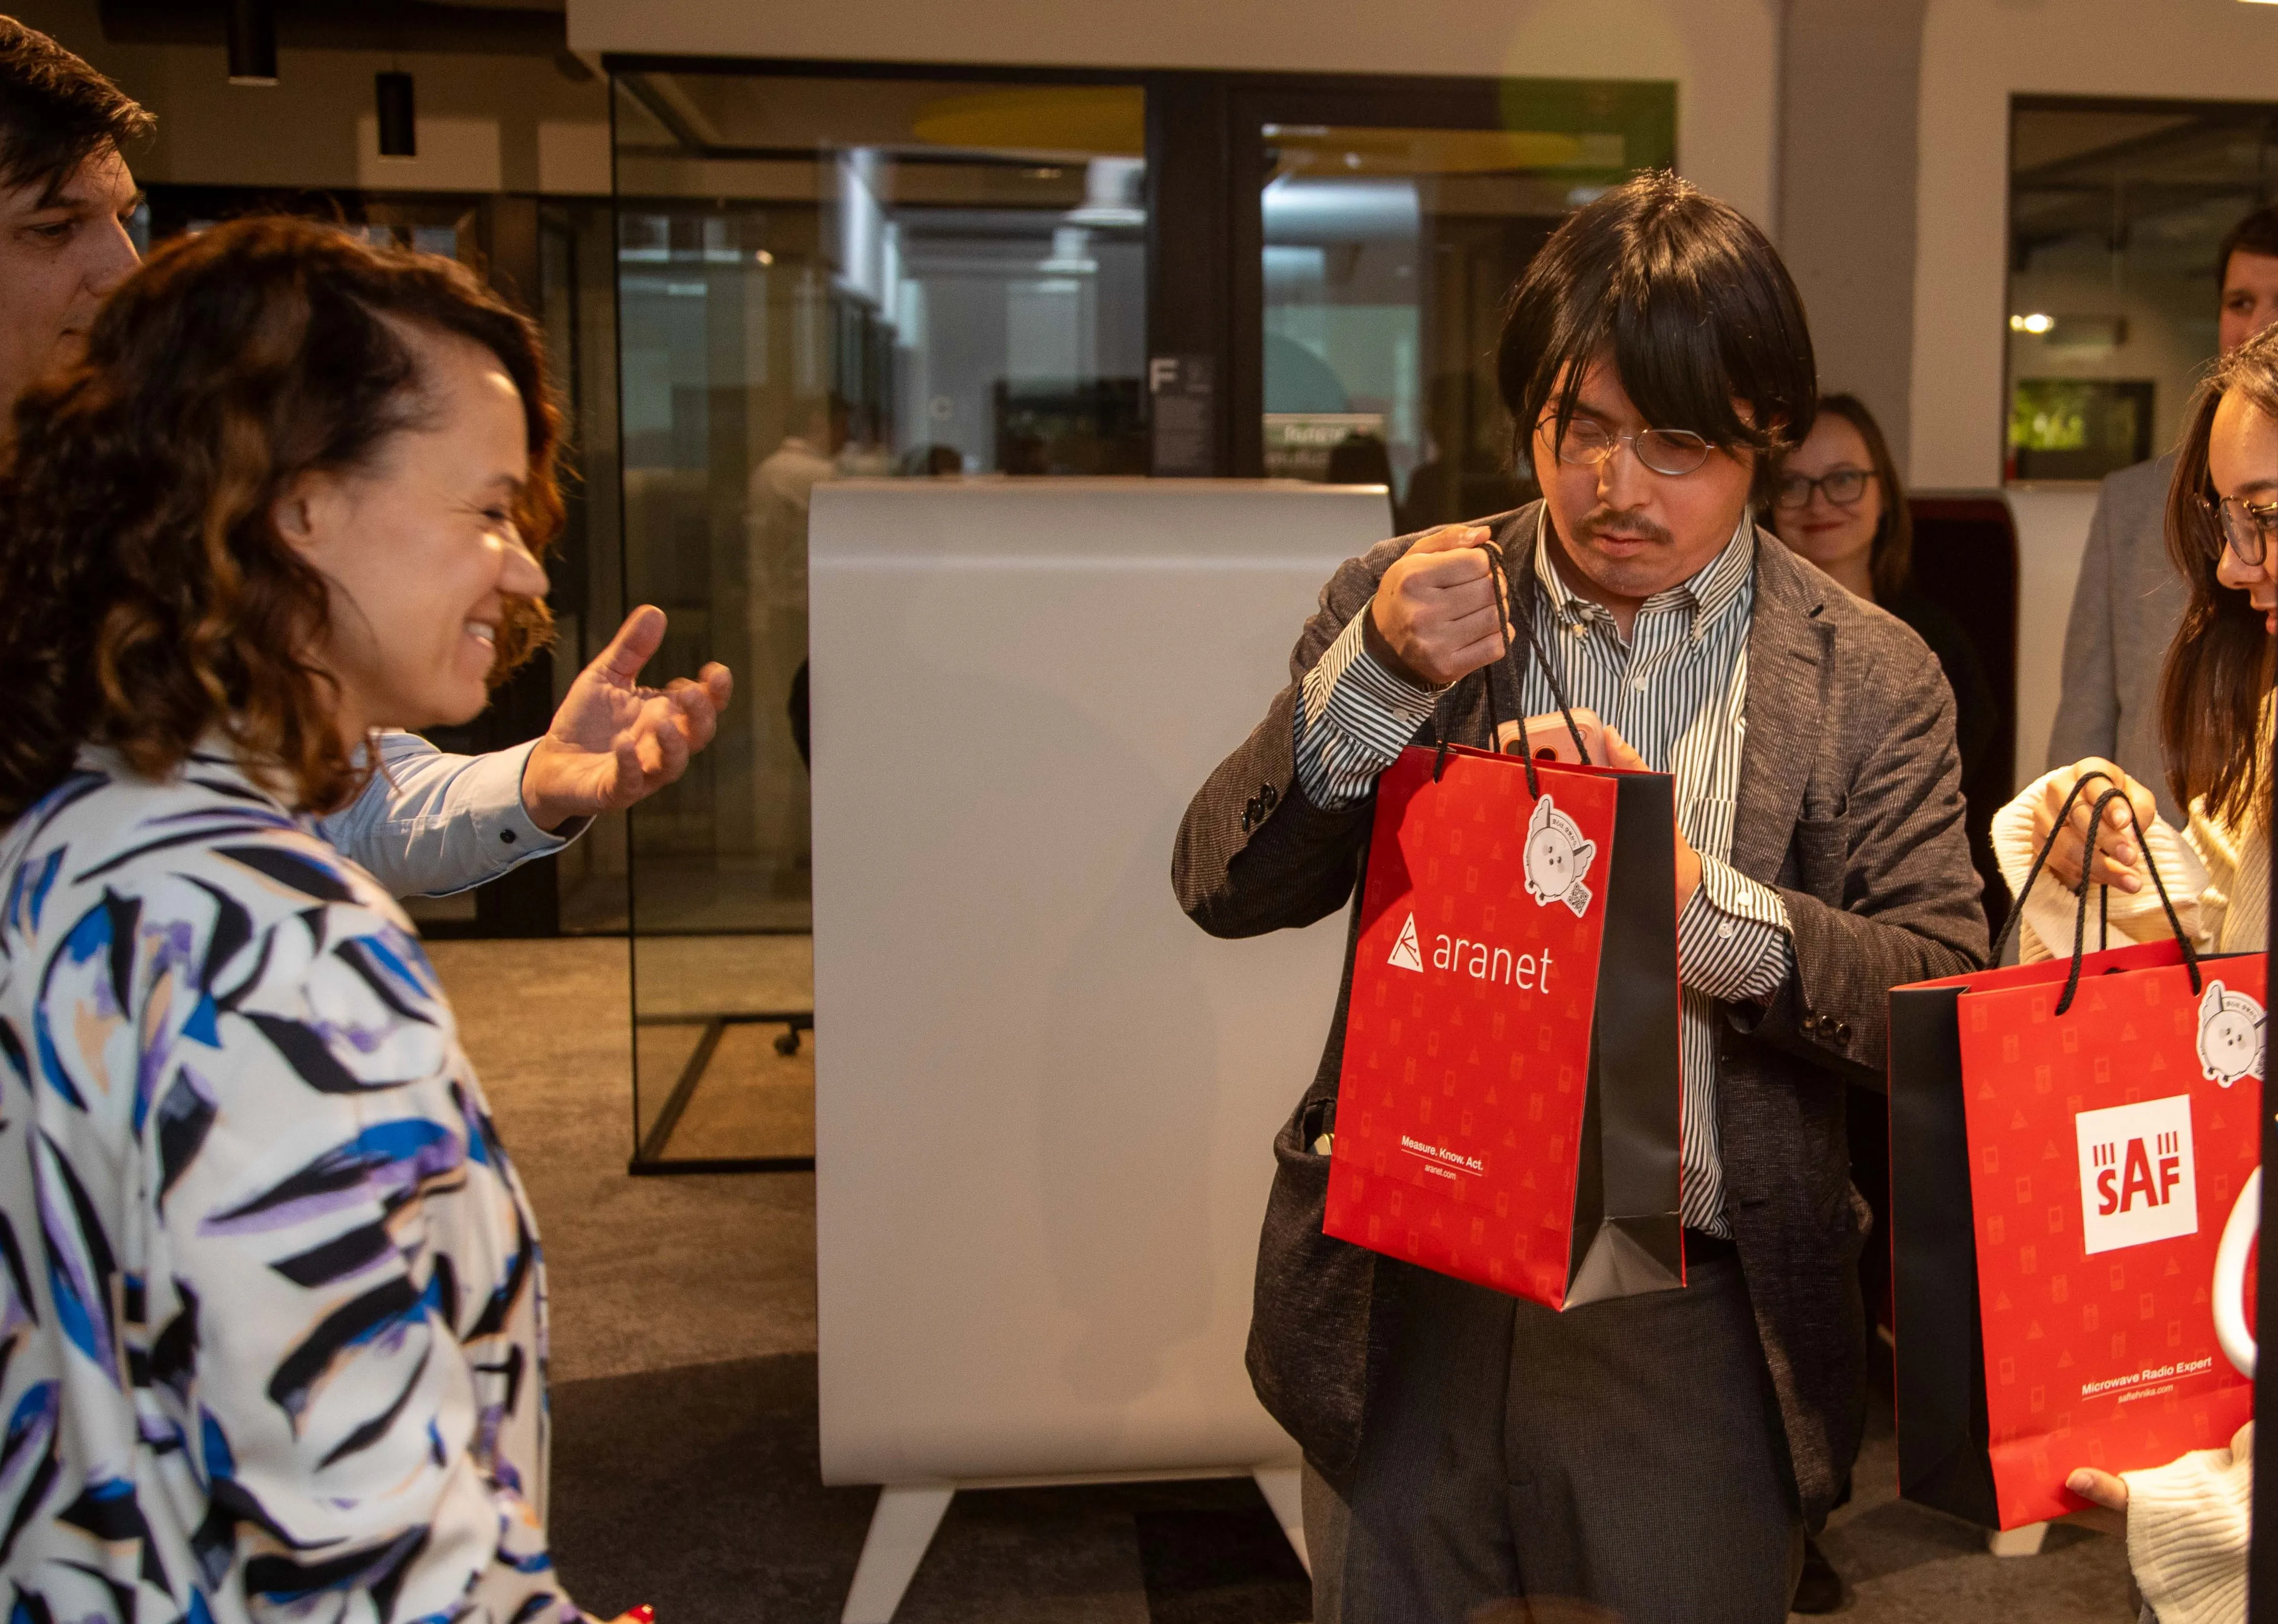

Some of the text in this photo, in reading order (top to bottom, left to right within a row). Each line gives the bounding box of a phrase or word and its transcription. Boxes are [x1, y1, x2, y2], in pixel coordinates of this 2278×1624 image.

[1150, 358, 1179, 393] F
[1433, 934, 1554, 994] aranet
[1401, 1135, 1483, 1171] Measure. Know. Act.
[1424, 1164, 1456, 1180] aranet.com
[2097, 1137, 2180, 1216] SAF
[2082, 1356, 2212, 1395] Microwave Radio Expert
[2118, 1384, 2173, 1403] saftehnika.com
